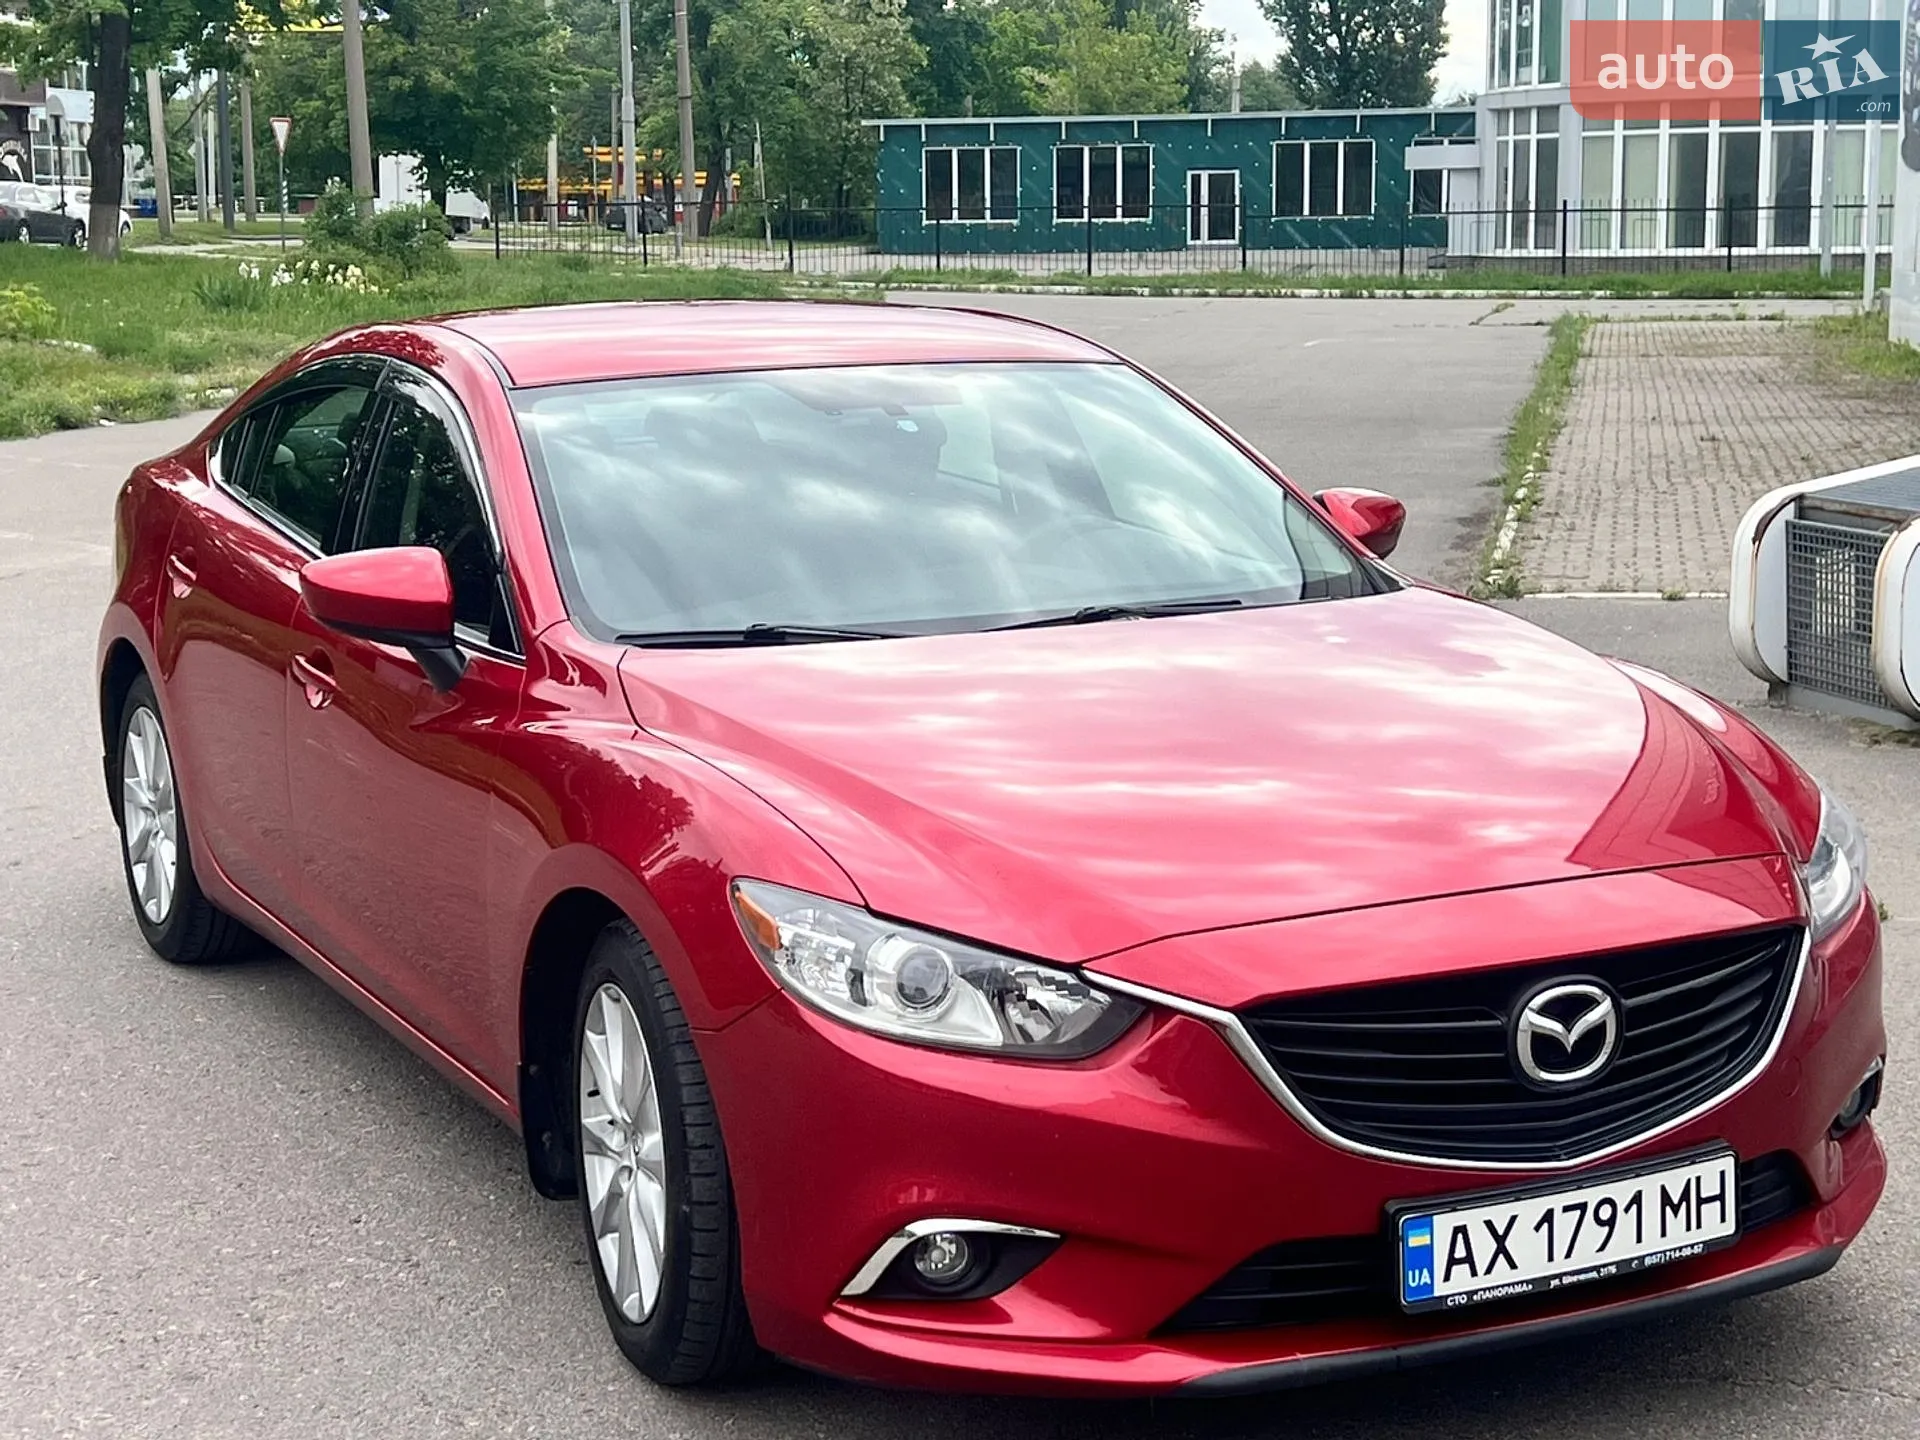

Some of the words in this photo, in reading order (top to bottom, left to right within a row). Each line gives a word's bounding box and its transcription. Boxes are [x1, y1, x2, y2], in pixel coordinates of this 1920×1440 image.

[1442, 1213, 1519, 1283] AX
[1533, 1189, 1643, 1263] 1791
[1660, 1169, 1727, 1238] MH
[1408, 1269, 1431, 1288] UA
[1447, 1294, 1467, 1306] СТО
